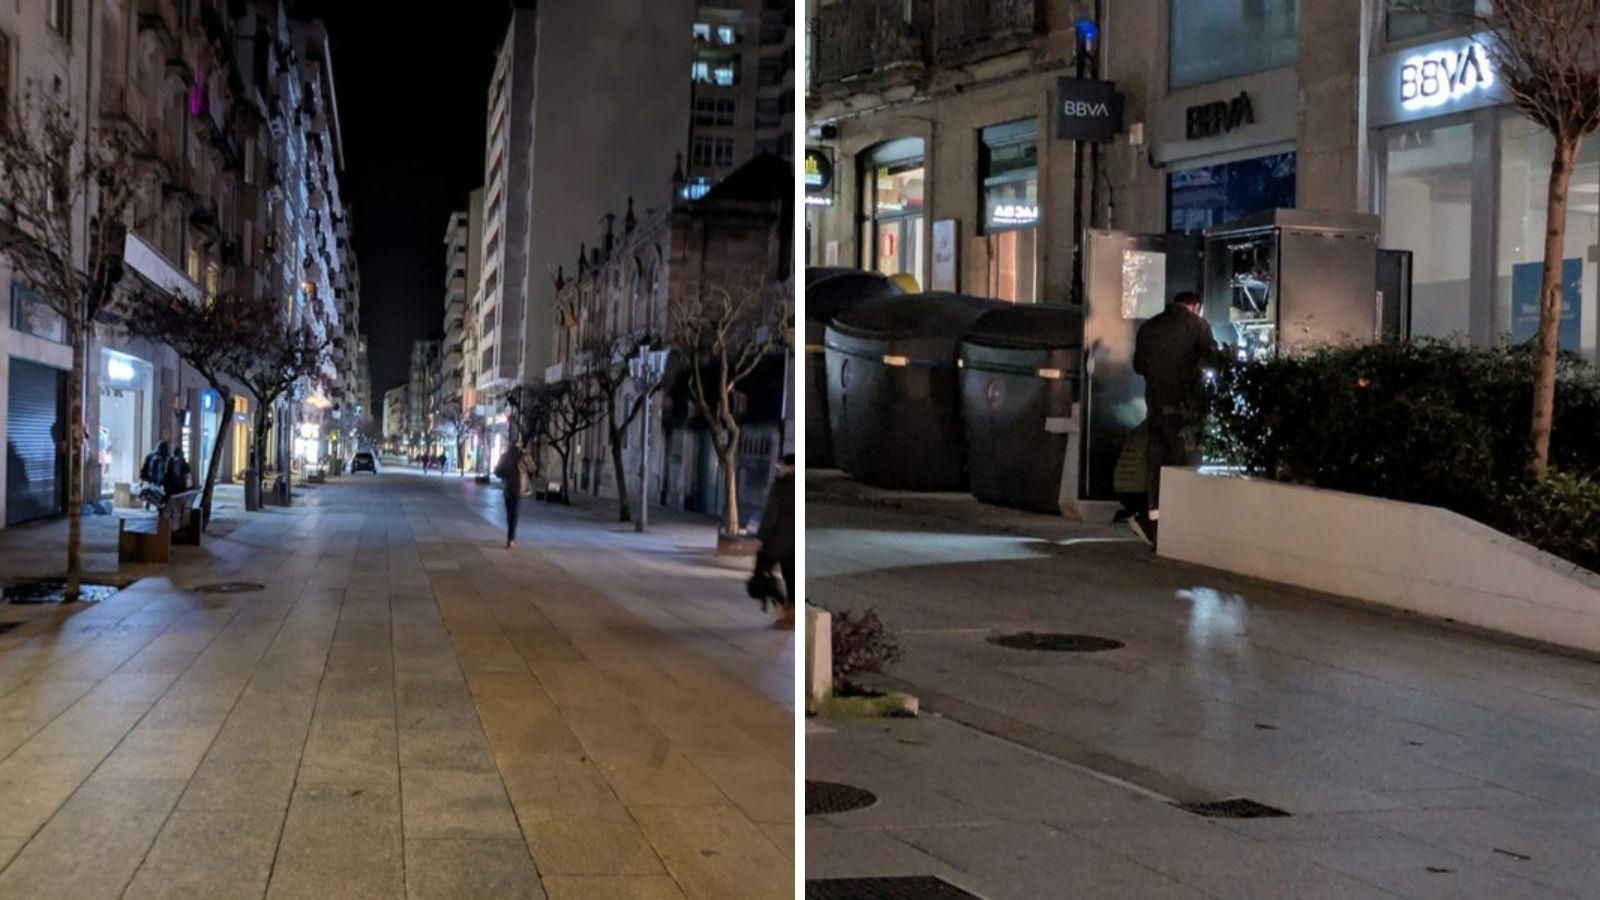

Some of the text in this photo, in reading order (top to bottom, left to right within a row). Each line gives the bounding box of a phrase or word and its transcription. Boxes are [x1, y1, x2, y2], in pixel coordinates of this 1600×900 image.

[1400, 45, 1484, 103] BBVA
[1064, 100, 1109, 117] BBVA
[1186, 90, 1255, 141] BBVA
